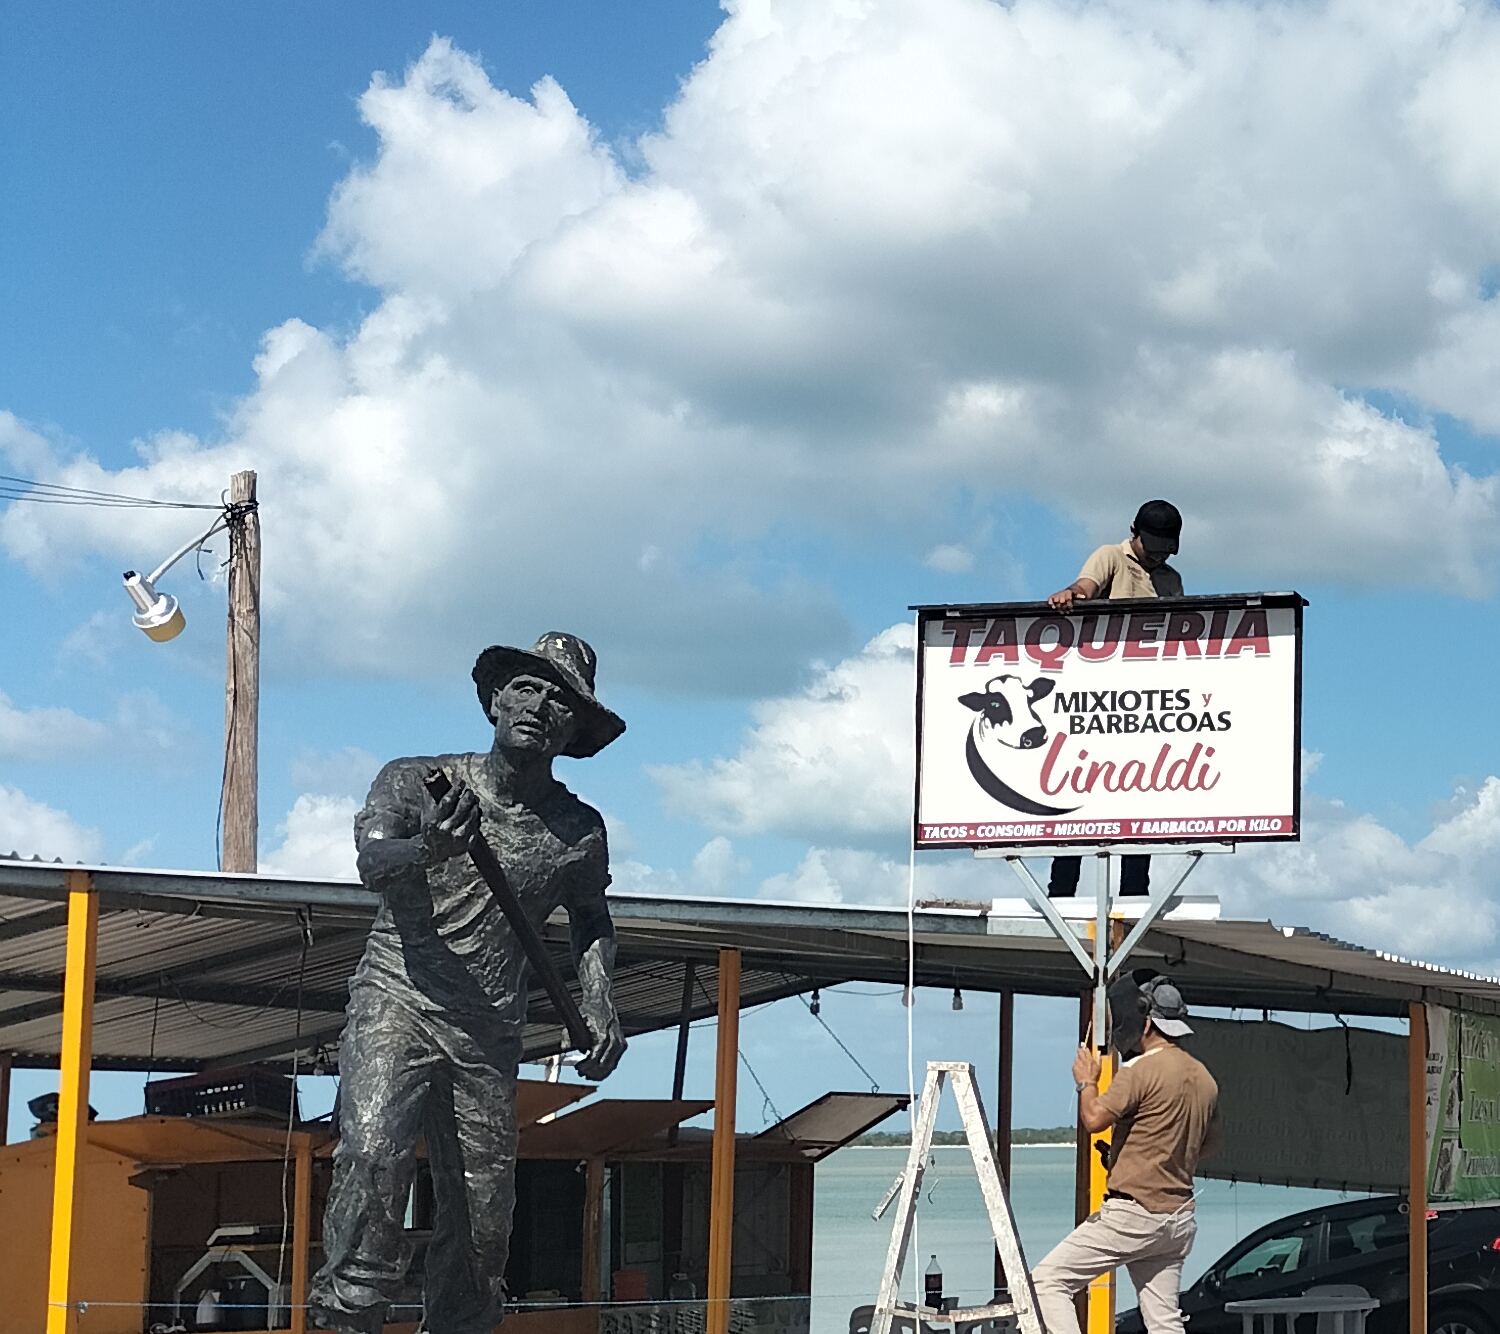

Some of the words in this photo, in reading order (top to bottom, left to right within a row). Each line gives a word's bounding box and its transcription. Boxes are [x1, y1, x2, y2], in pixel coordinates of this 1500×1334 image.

[942, 609, 1271, 673] TAQUERIA
[1053, 688, 1190, 714] MIXIOTES
[1069, 711, 1232, 735] BARBACOAS
[1039, 731, 1221, 796] Linaldi
[923, 825, 968, 839] TACOS
[976, 823, 1045, 838] CONSOME
[1053, 822, 1121, 836] MIXIOTES
[1130, 822, 1141, 834] Y
[1141, 820, 1215, 835] BARBACOA
[1217, 819, 1248, 832] POR
[1249, 818, 1282, 832] KILO
